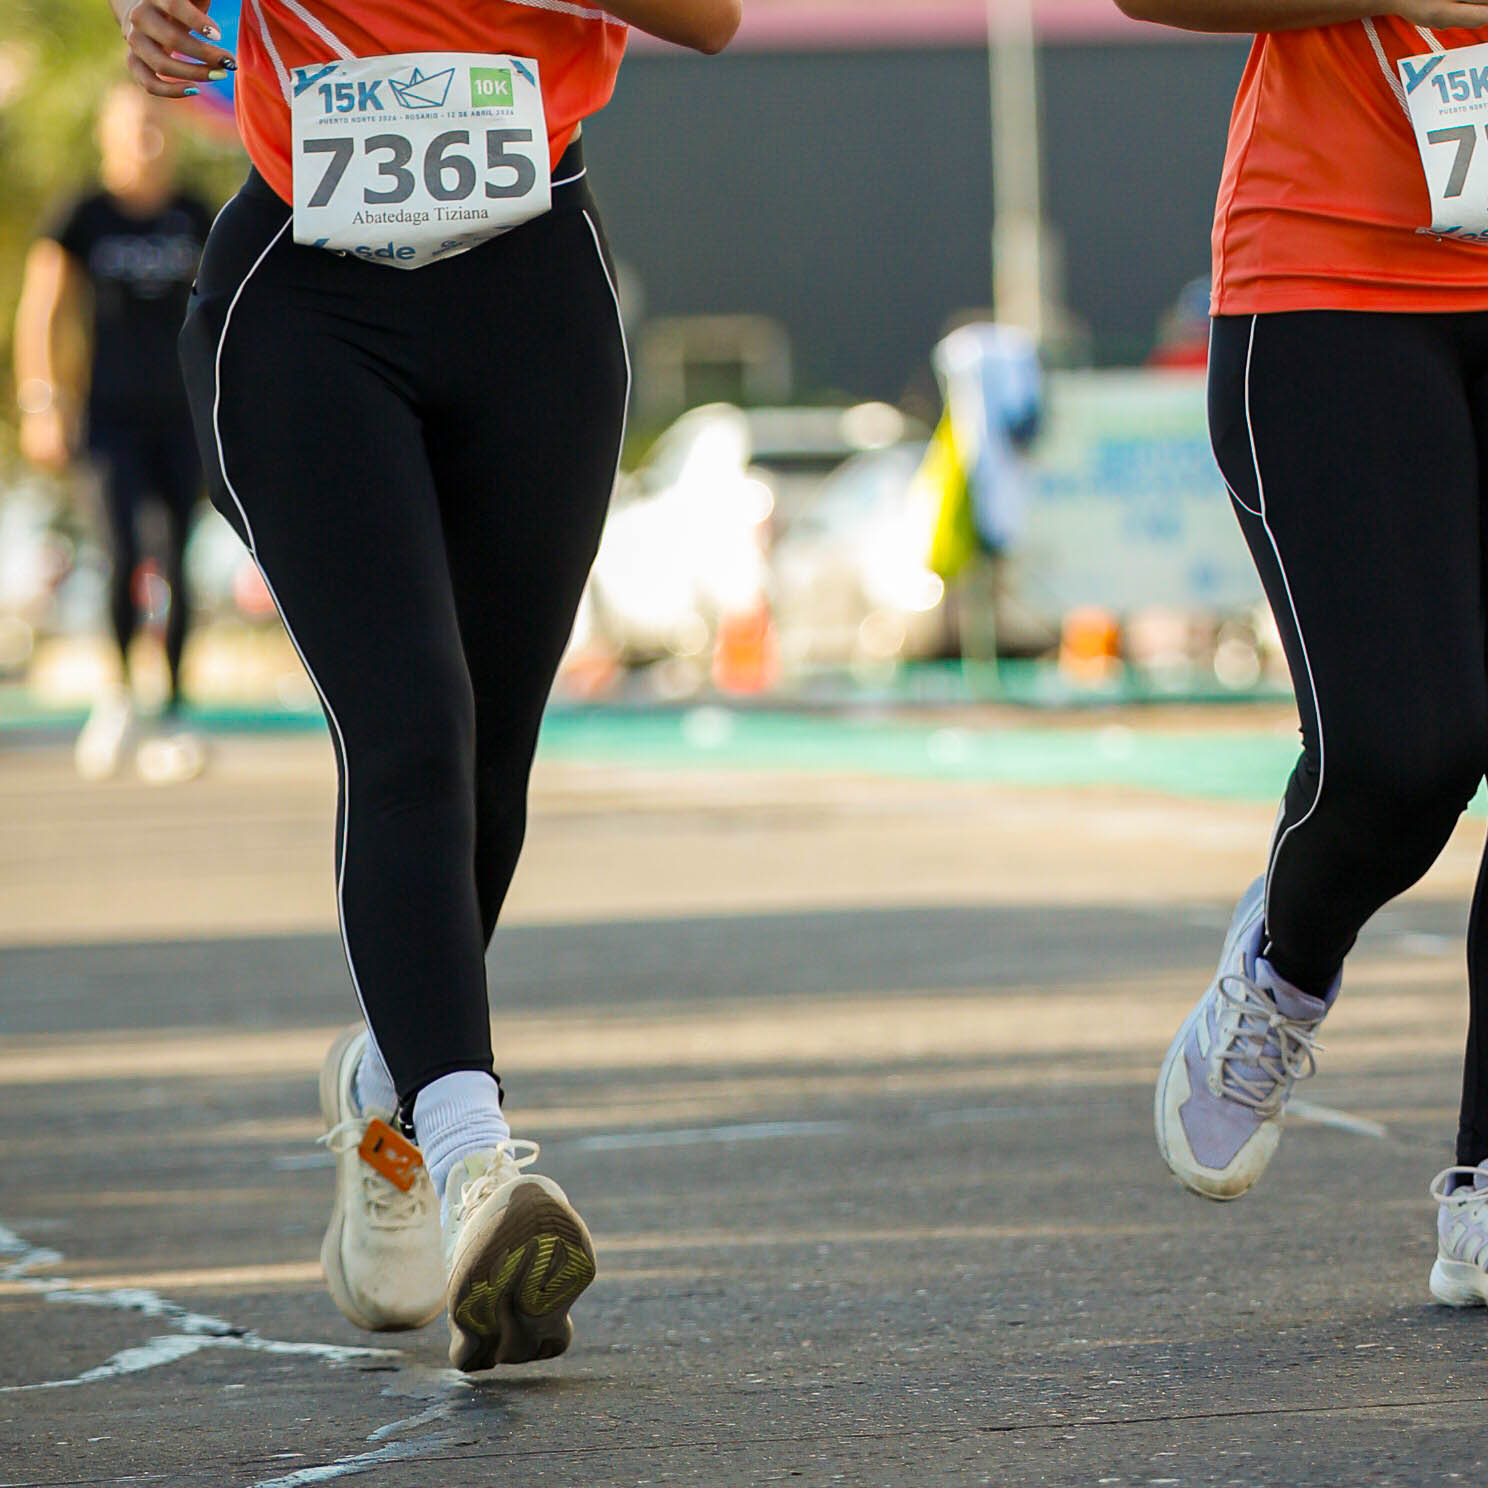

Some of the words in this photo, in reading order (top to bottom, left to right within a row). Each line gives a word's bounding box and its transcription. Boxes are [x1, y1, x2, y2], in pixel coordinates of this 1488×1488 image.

[317, 79, 385, 114] 15K
[474, 78, 509, 96] 10K
[302, 128, 537, 208] 7365
[352, 208, 430, 226] Abatedaga
[433, 206, 489, 222] Tiziana
[354, 241, 417, 260] sde
